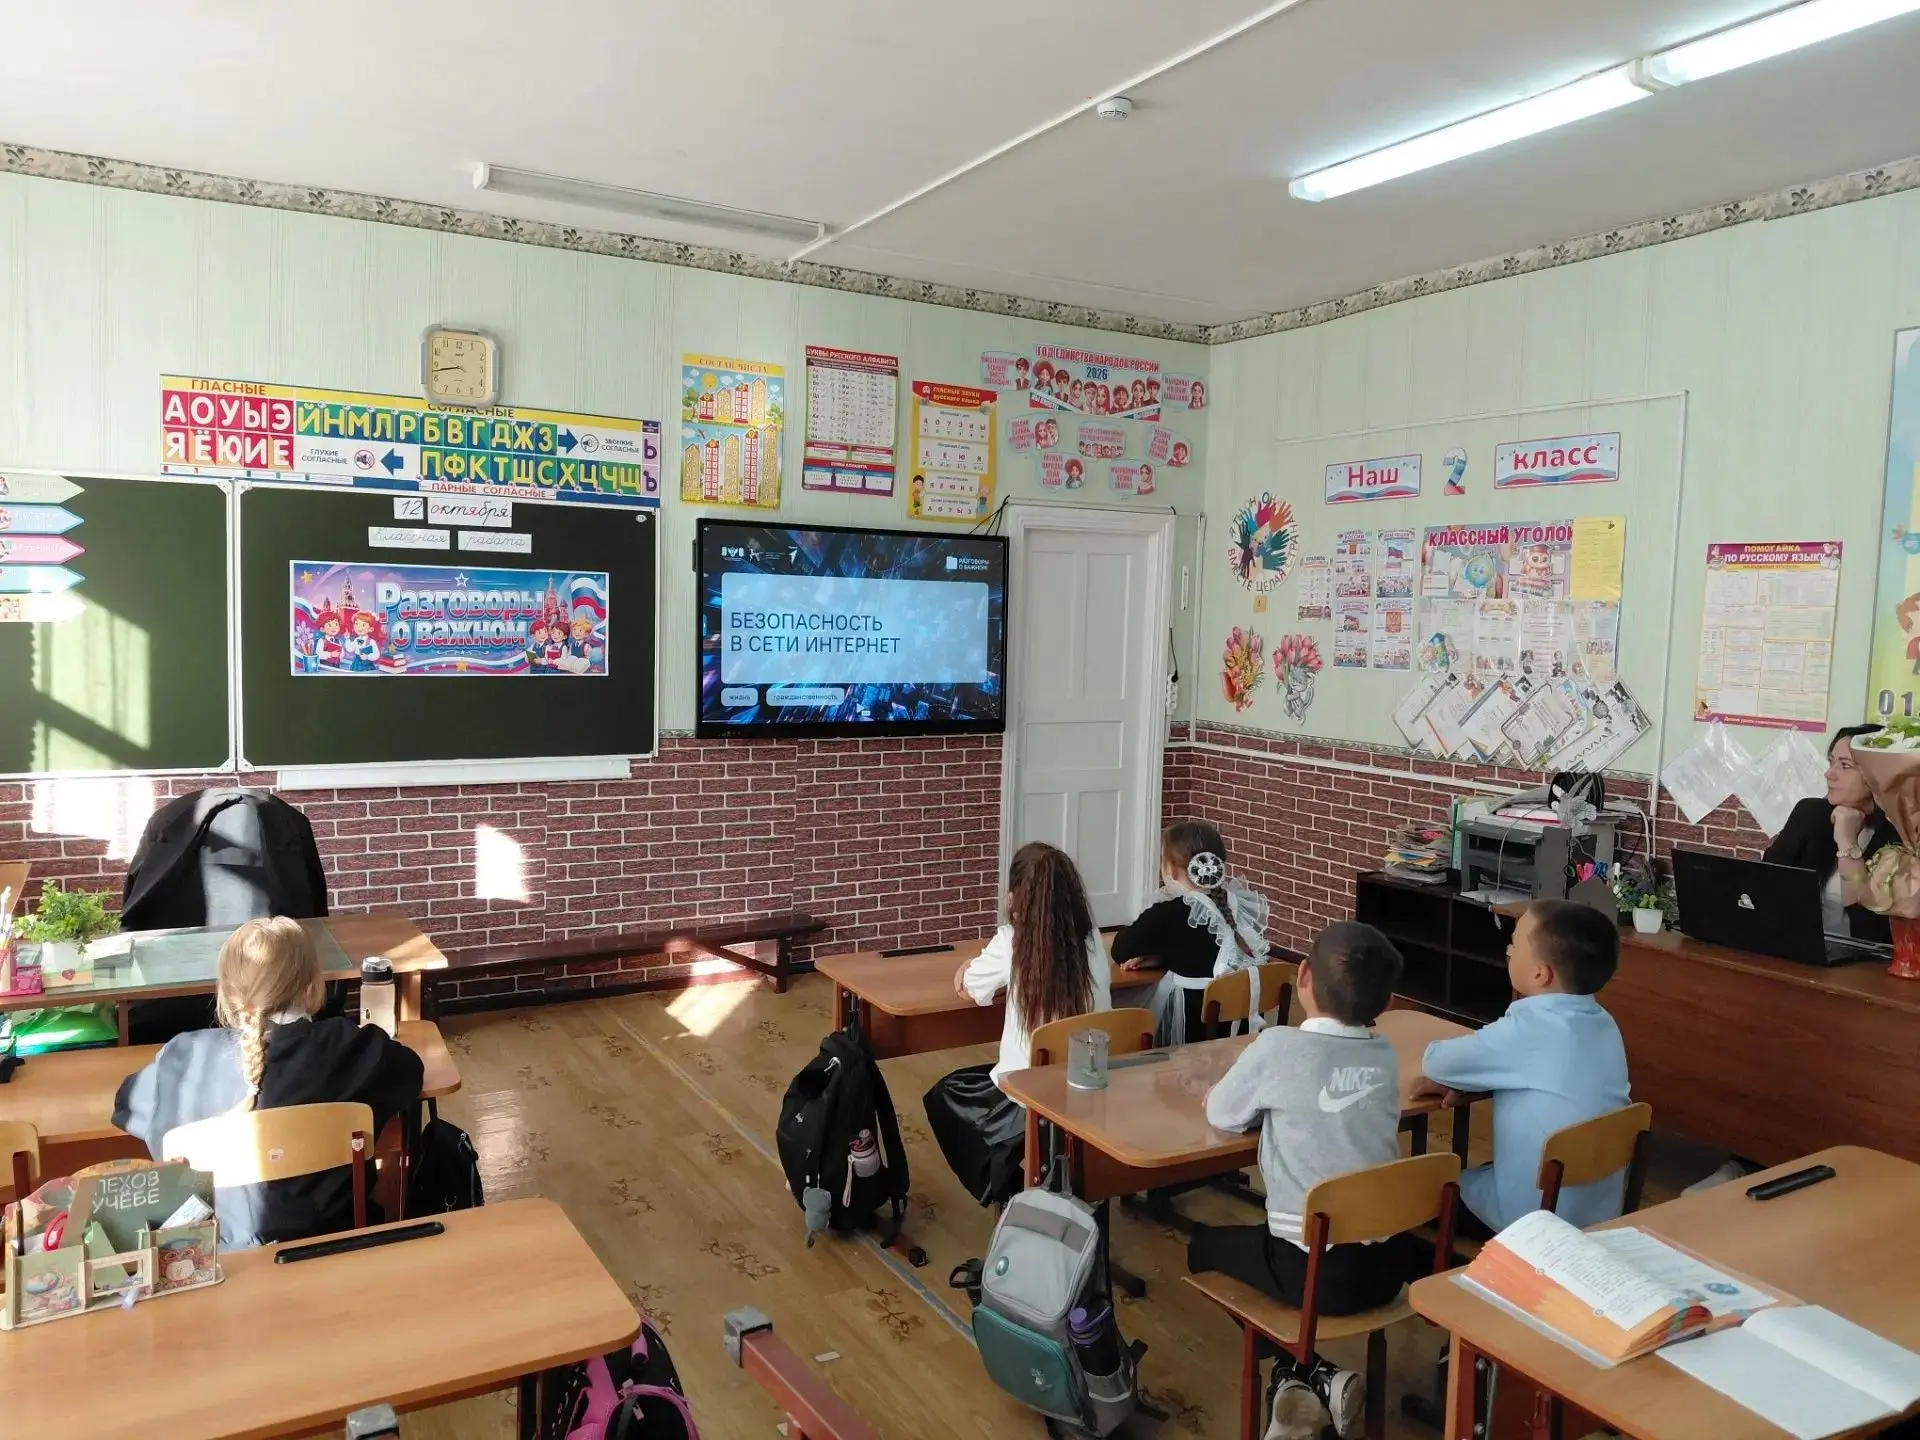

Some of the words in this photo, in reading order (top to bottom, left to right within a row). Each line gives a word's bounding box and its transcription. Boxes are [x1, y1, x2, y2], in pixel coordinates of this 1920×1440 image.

[807, 348, 828, 356] БУКВЫ
[830, 352, 861, 360] РУССКОГО
[862, 356, 896, 366] АЛФАВИТА
[1036, 345, 1053, 360] ГОД
[1055, 348, 1095, 364] ЕДИНСТВА
[1096, 354, 1129, 368] НАРОДОВ
[1130, 358, 1160, 372] РОССИИ
[1086, 366, 1108, 380] 2026
[191, 378, 267, 396] ГЛАСНЫЕ
[933, 387, 961, 396] ГЛАСНЫЕ
[962, 390, 980, 398] ЗВУКИ
[602, 444, 640, 454] СОГЛАСНЫЕ
[605, 438, 634, 447] ЗВОНКИЕ
[302, 455, 348, 465] СОГЛАСНЫЕ
[310, 448, 338, 457] ГЛУХИЕ
[1513, 443, 1600, 470] класс
[1347, 465, 1399, 488] Наш
[1442, 447, 1468, 496] 2
[432, 482, 477, 494] ПАРНЫЕ
[482, 485, 547, 499] СОГЛАСНЫЕ
[402, 500, 422, 516] 12
[1228, 526, 1236, 539] Я
[1428, 526, 1509, 547] КЛАССНЫЙ
[1744, 544, 1801, 552] ПОМОГАЙКА
[1724, 554, 1737, 562] ПО
[1740, 554, 1789, 562] РУССКОМУ
[1791, 553, 1826, 562] ЯЗЫКУ
[1228, 547, 1252, 592] ВМЕСТЕ
[1256, 568, 1287, 594] ЦЕЛАЯ
[376, 582, 545, 624] Разговоры
[730, 612, 883, 632] БЕЗОПАСНОСТЬ
[730, 635, 742, 652] В
[748, 636, 799, 653] СЕТИ
[806, 636, 901, 654] ИНТЕРНЕТ
[1329, 1067, 1374, 1092] NIKE
[92, 1188, 160, 1214] УЧЁБЕ
